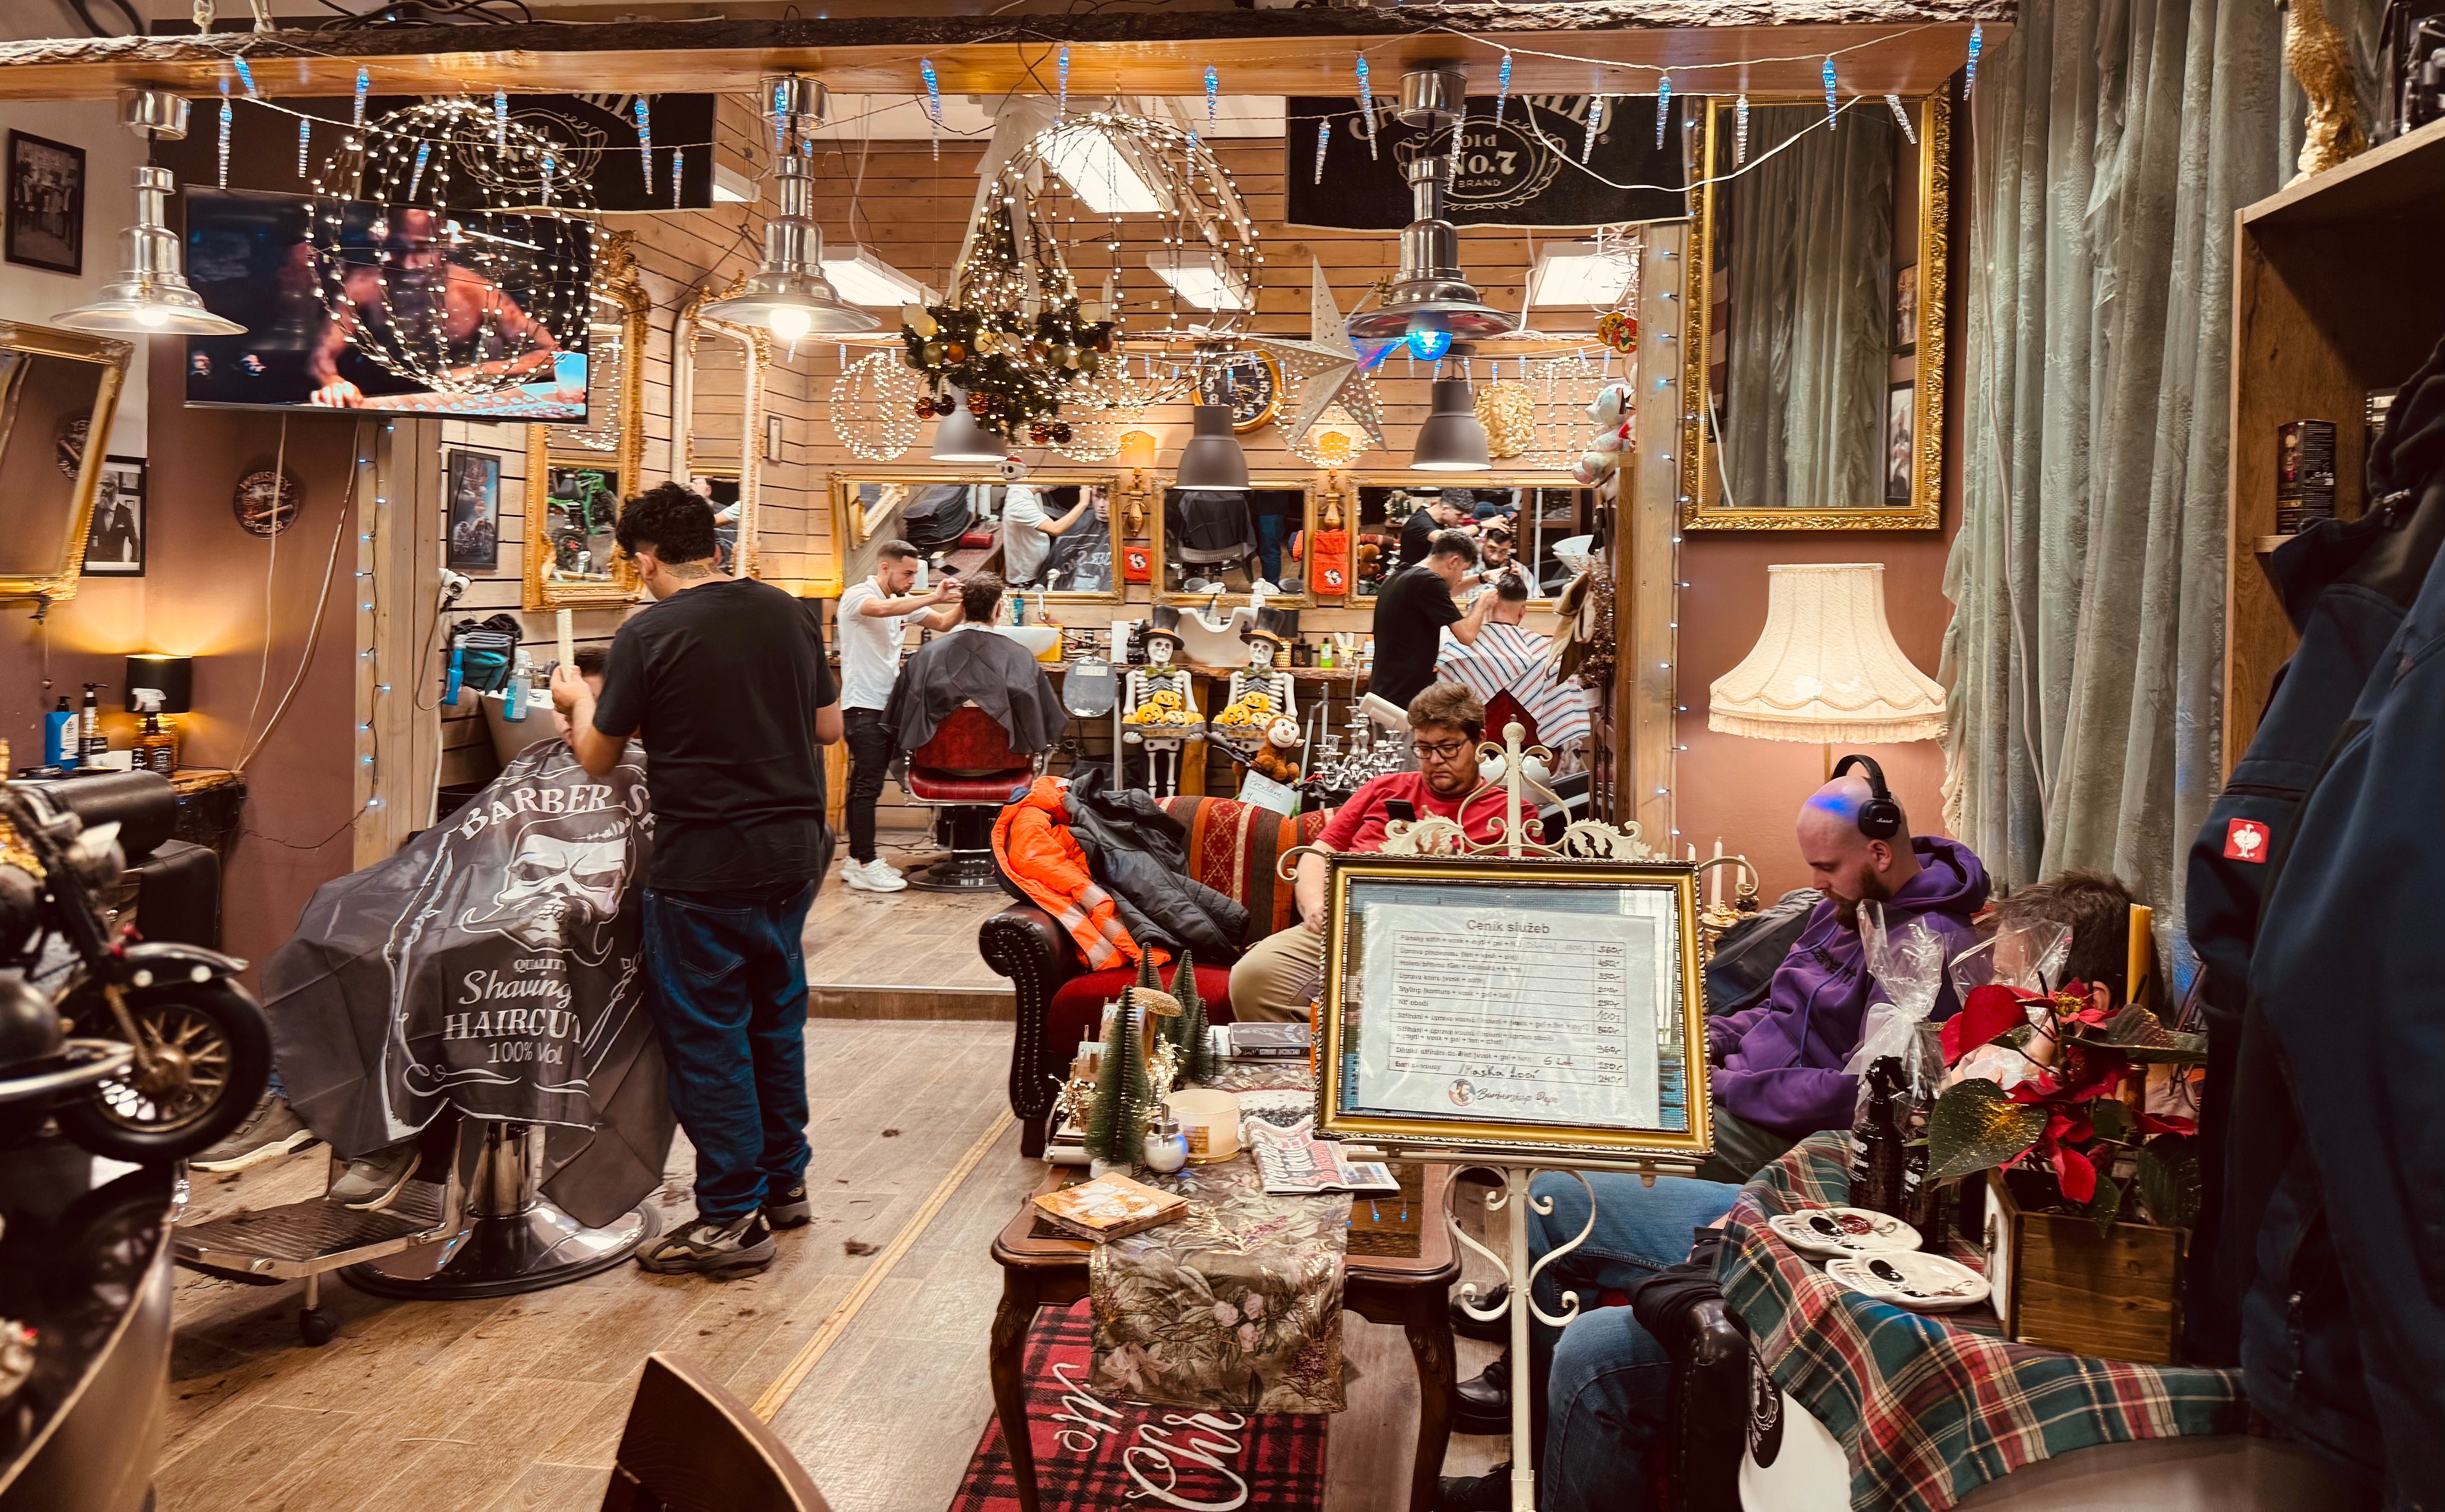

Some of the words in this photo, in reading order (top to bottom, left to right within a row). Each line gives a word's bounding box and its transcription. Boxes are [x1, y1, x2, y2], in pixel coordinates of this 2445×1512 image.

[1259, 381, 1270, 393] 3
[460, 784, 613, 840] BARBER
[457, 970, 572, 1009] Shaving
[487, 1041, 533, 1064] 100%
